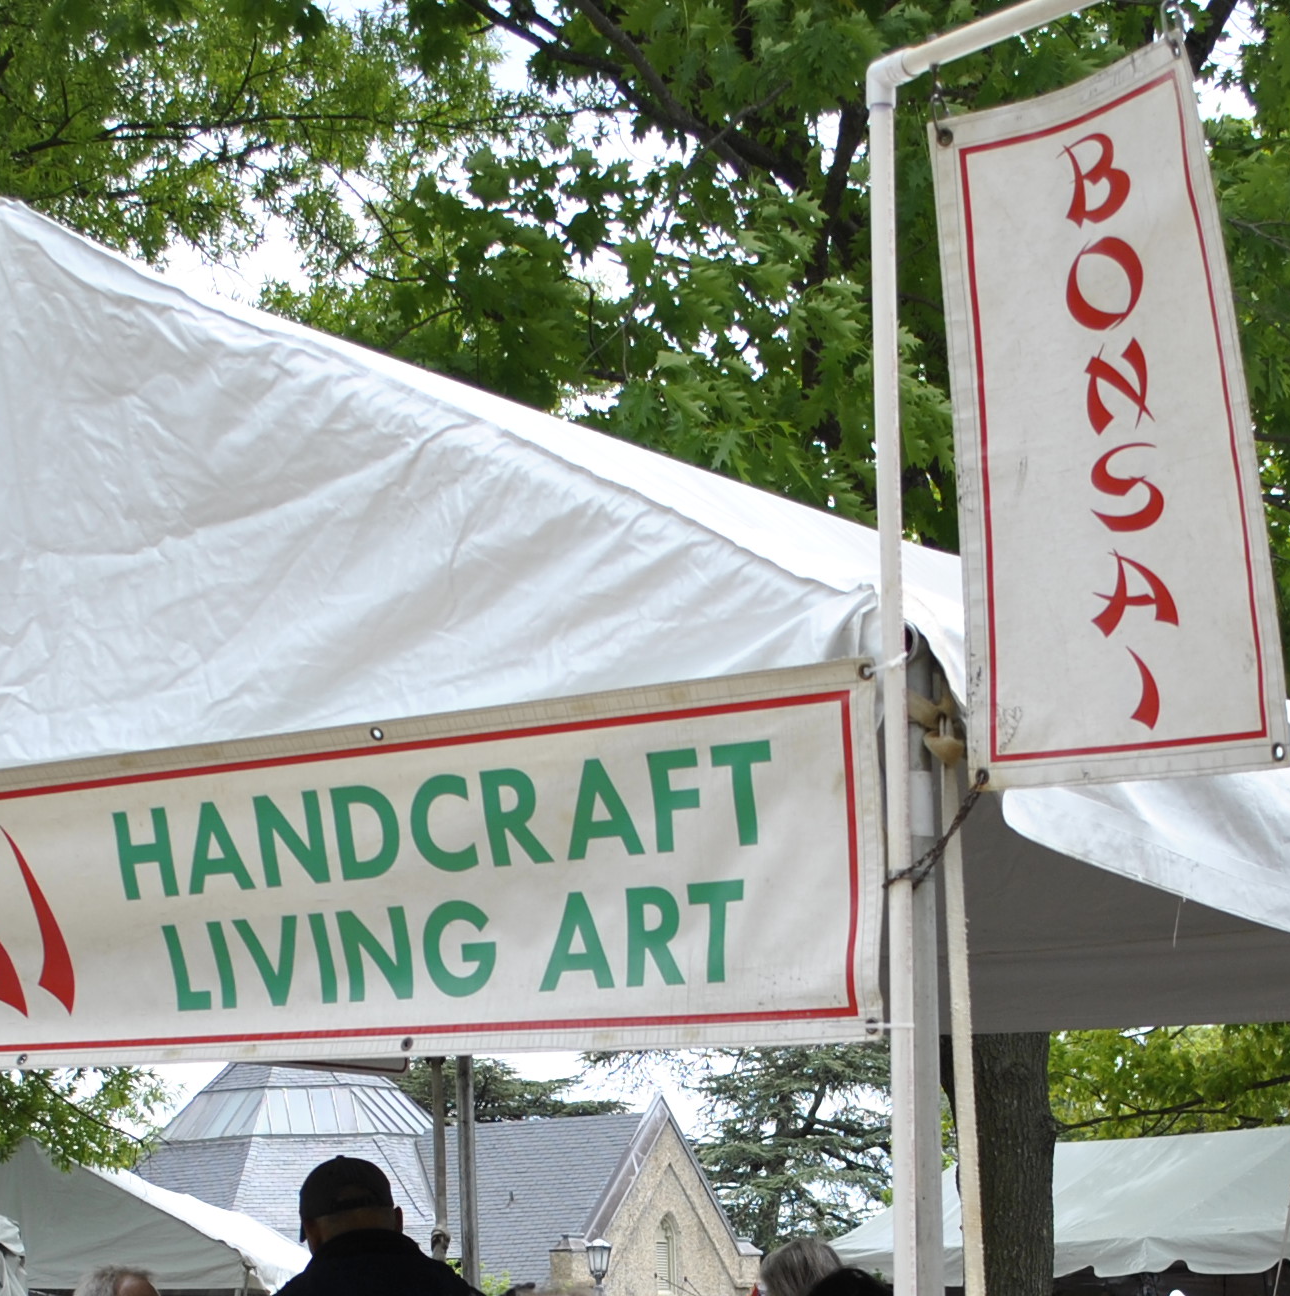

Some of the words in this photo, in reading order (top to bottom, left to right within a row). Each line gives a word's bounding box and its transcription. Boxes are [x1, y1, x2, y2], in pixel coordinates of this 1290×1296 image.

[1057, 133, 1179, 729] BONSAI
[112, 739, 773, 900] HANDCRAFT
[161, 900, 497, 1012] LIVING
[539, 879, 745, 992] ART
